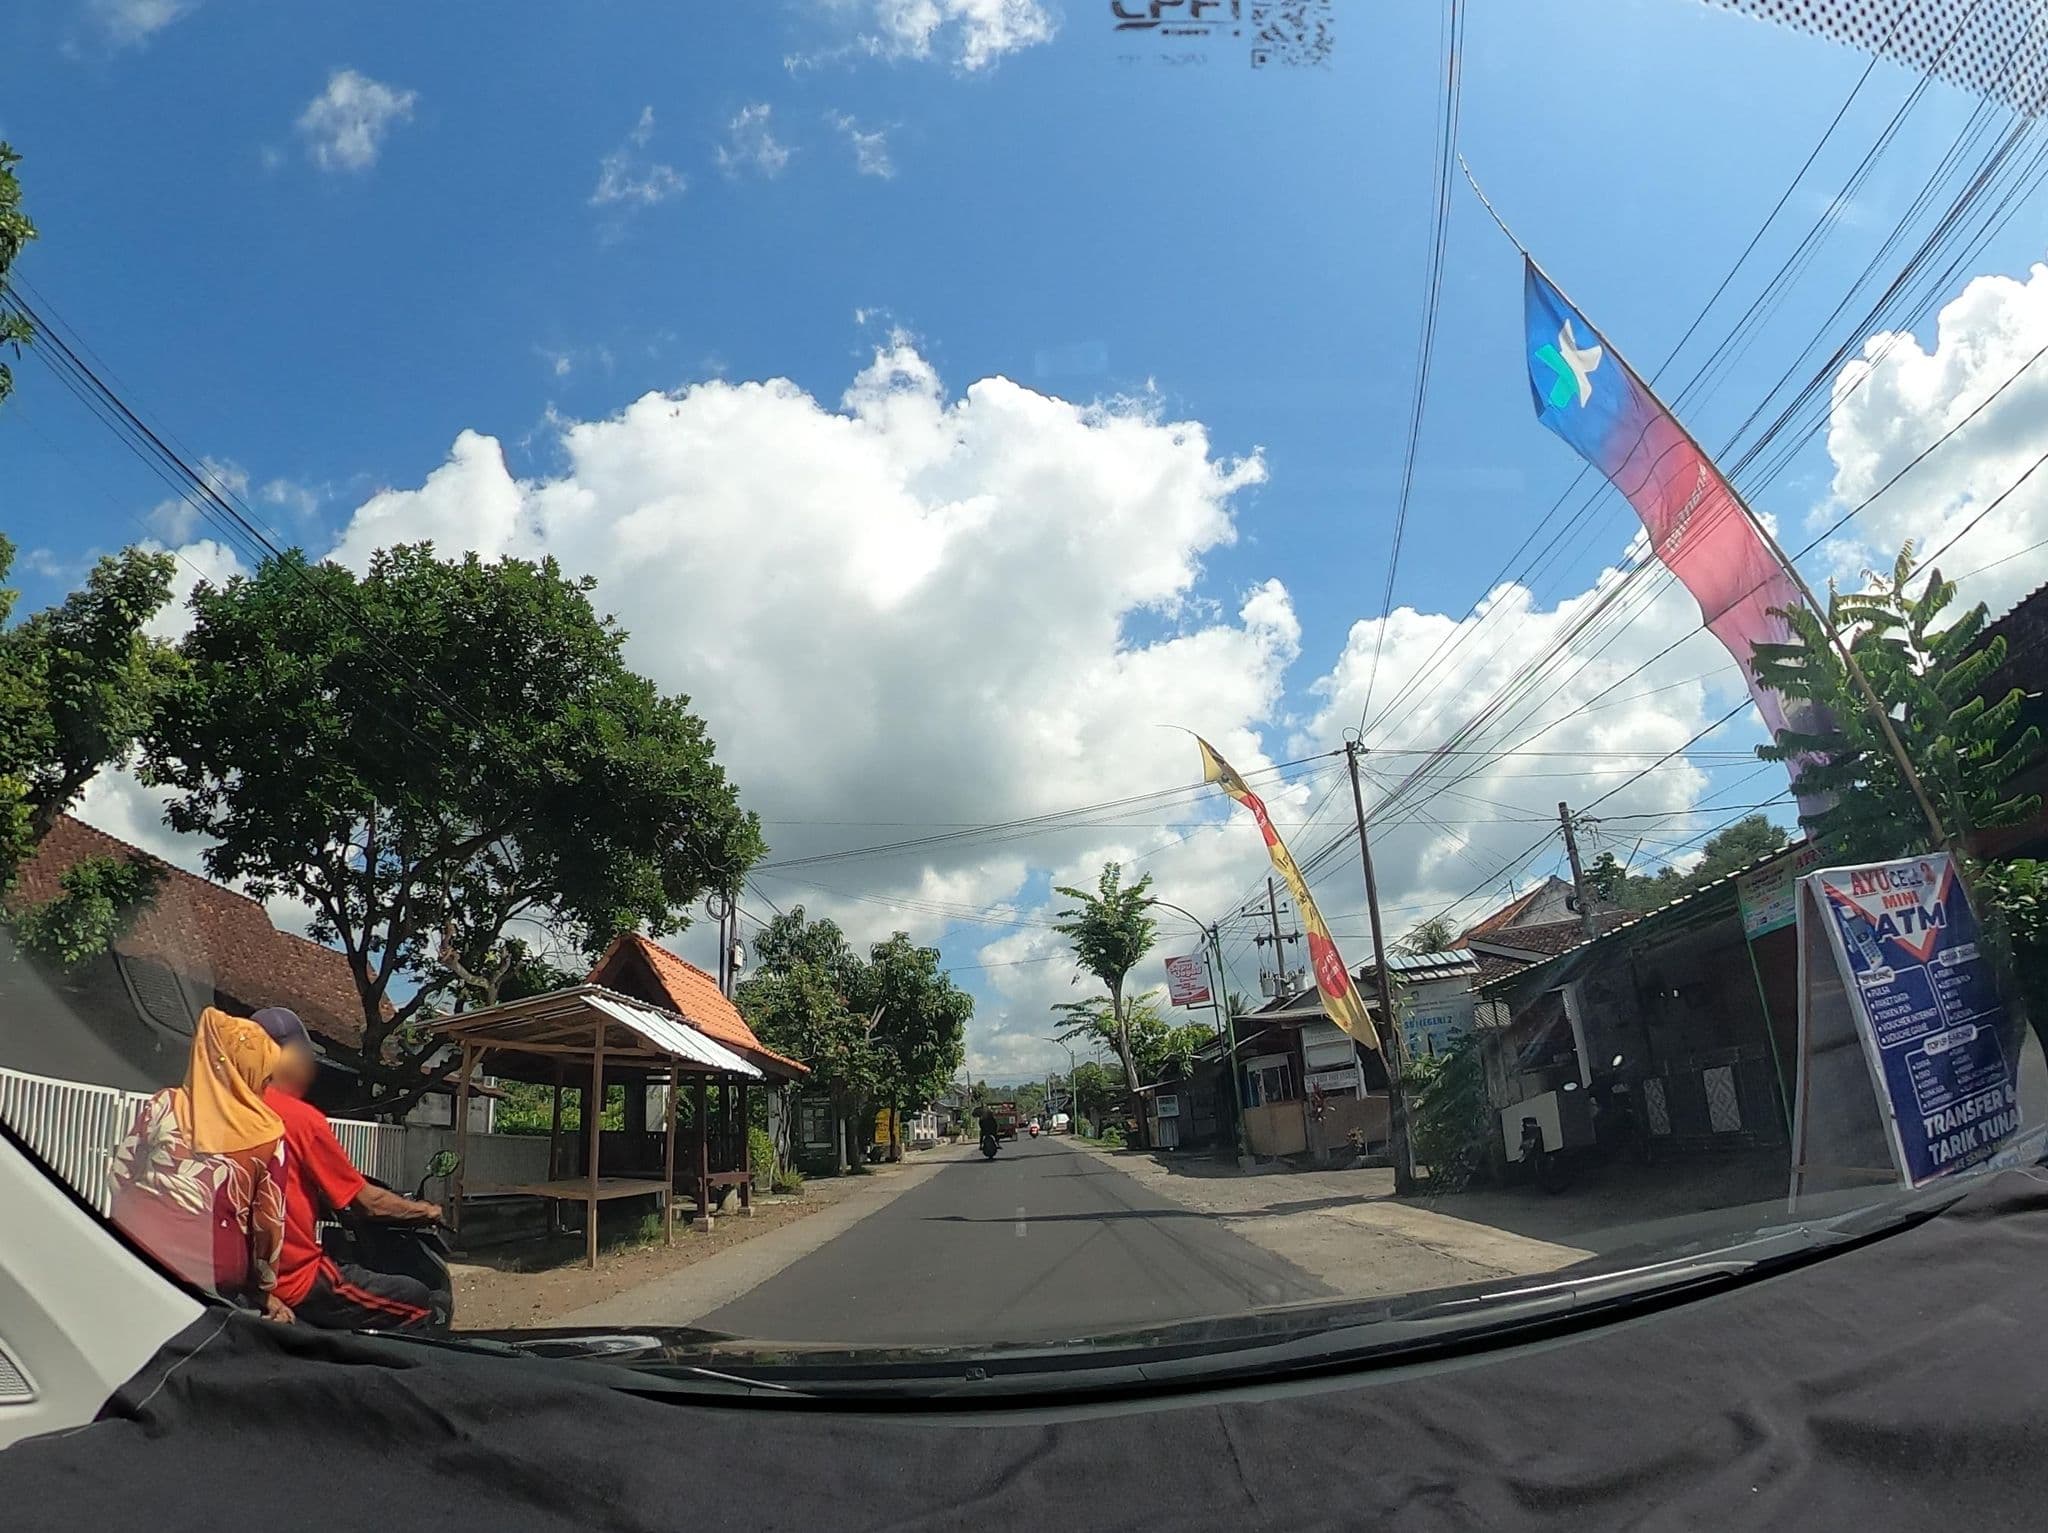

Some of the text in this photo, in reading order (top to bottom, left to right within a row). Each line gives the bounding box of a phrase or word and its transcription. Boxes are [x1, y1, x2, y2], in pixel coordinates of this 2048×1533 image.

[1882, 890, 1920, 909] MINI
[1876, 901, 1946, 939] ATM
[1924, 1089, 2004, 1139] TRANSFER
[1929, 1126, 1979, 1166] TARIK
